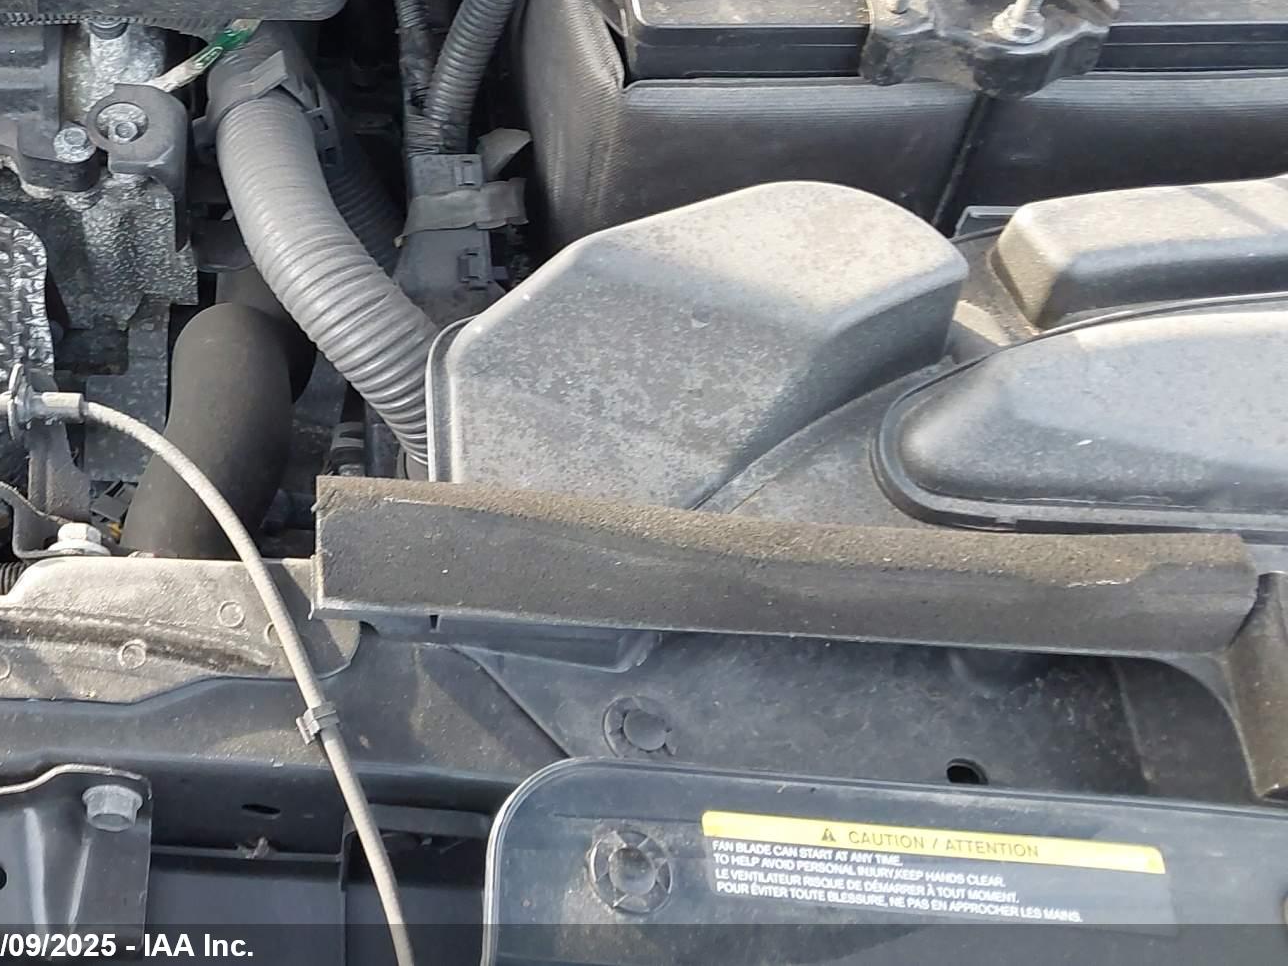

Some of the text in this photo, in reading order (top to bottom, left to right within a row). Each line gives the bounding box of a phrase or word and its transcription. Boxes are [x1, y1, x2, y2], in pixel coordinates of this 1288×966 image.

[712, 841, 903, 866] FAN BLADE CAN START AT ANY TIME.
[848, 830, 924, 849] CAUTION
[945, 838, 1039, 857] ATTENTION
[714, 853, 729, 864] TO
[731, 855, 760, 867] HELP
[762, 857, 795, 870] AVOID
[797, 860, 855, 875] PERSONAL
[925, 871, 964, 884] HANDS
[967, 874, 1006, 887] CLEAR.
[715, 868, 729, 879] LE
[731, 869, 801, 886] VENTILATEUR
[803, 876, 844, 890] RISQUE
[847, 880, 862, 891] DE
[864, 879, 924, 896] DÉMARRER
[937, 887, 966, 899] TOUT
[968, 889, 1019, 903] MOMENT.
[717, 882, 1083, 922] POUR ÉVITER TOUTE BLESSURE, NE PAS EN APPROCHER LES MAINS.
